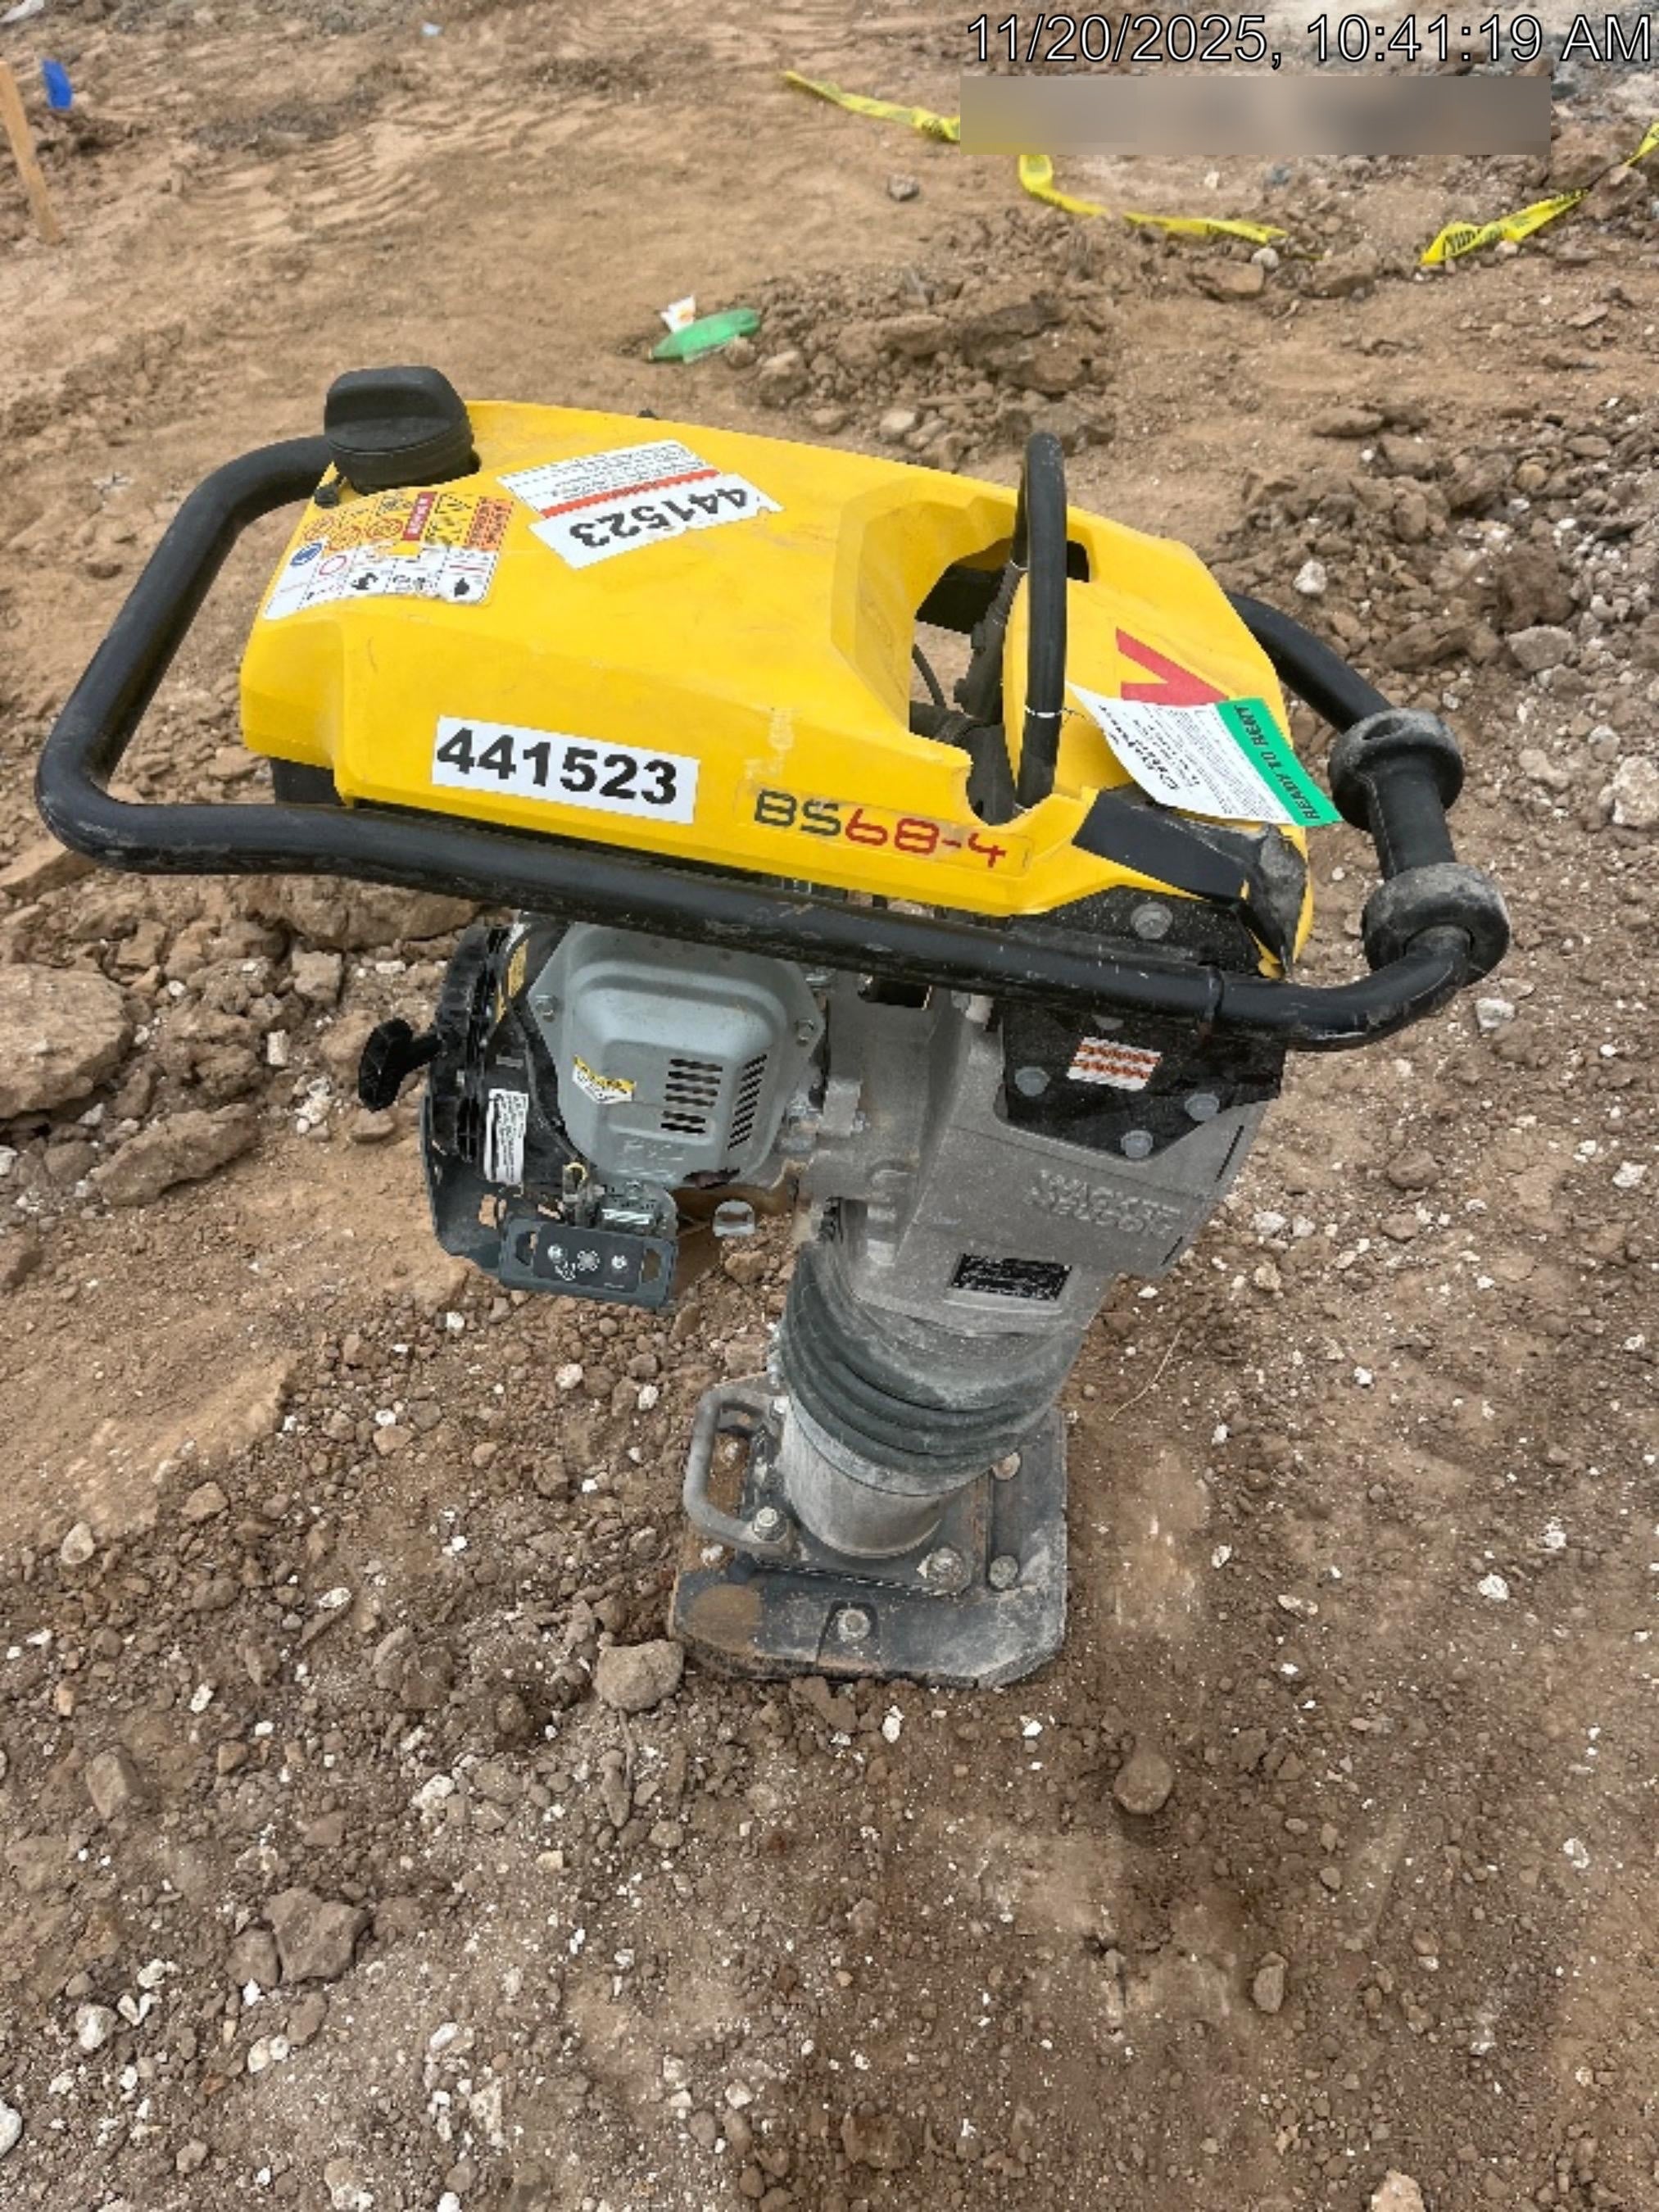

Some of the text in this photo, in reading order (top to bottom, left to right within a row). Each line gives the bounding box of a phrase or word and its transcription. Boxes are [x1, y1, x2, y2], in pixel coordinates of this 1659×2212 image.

[570, 488, 747, 547] 441523
[437, 728, 677, 805] 441523
[1234, 705, 1321, 818] READY TO RENT
[755, 789, 1007, 868] BS68-4
